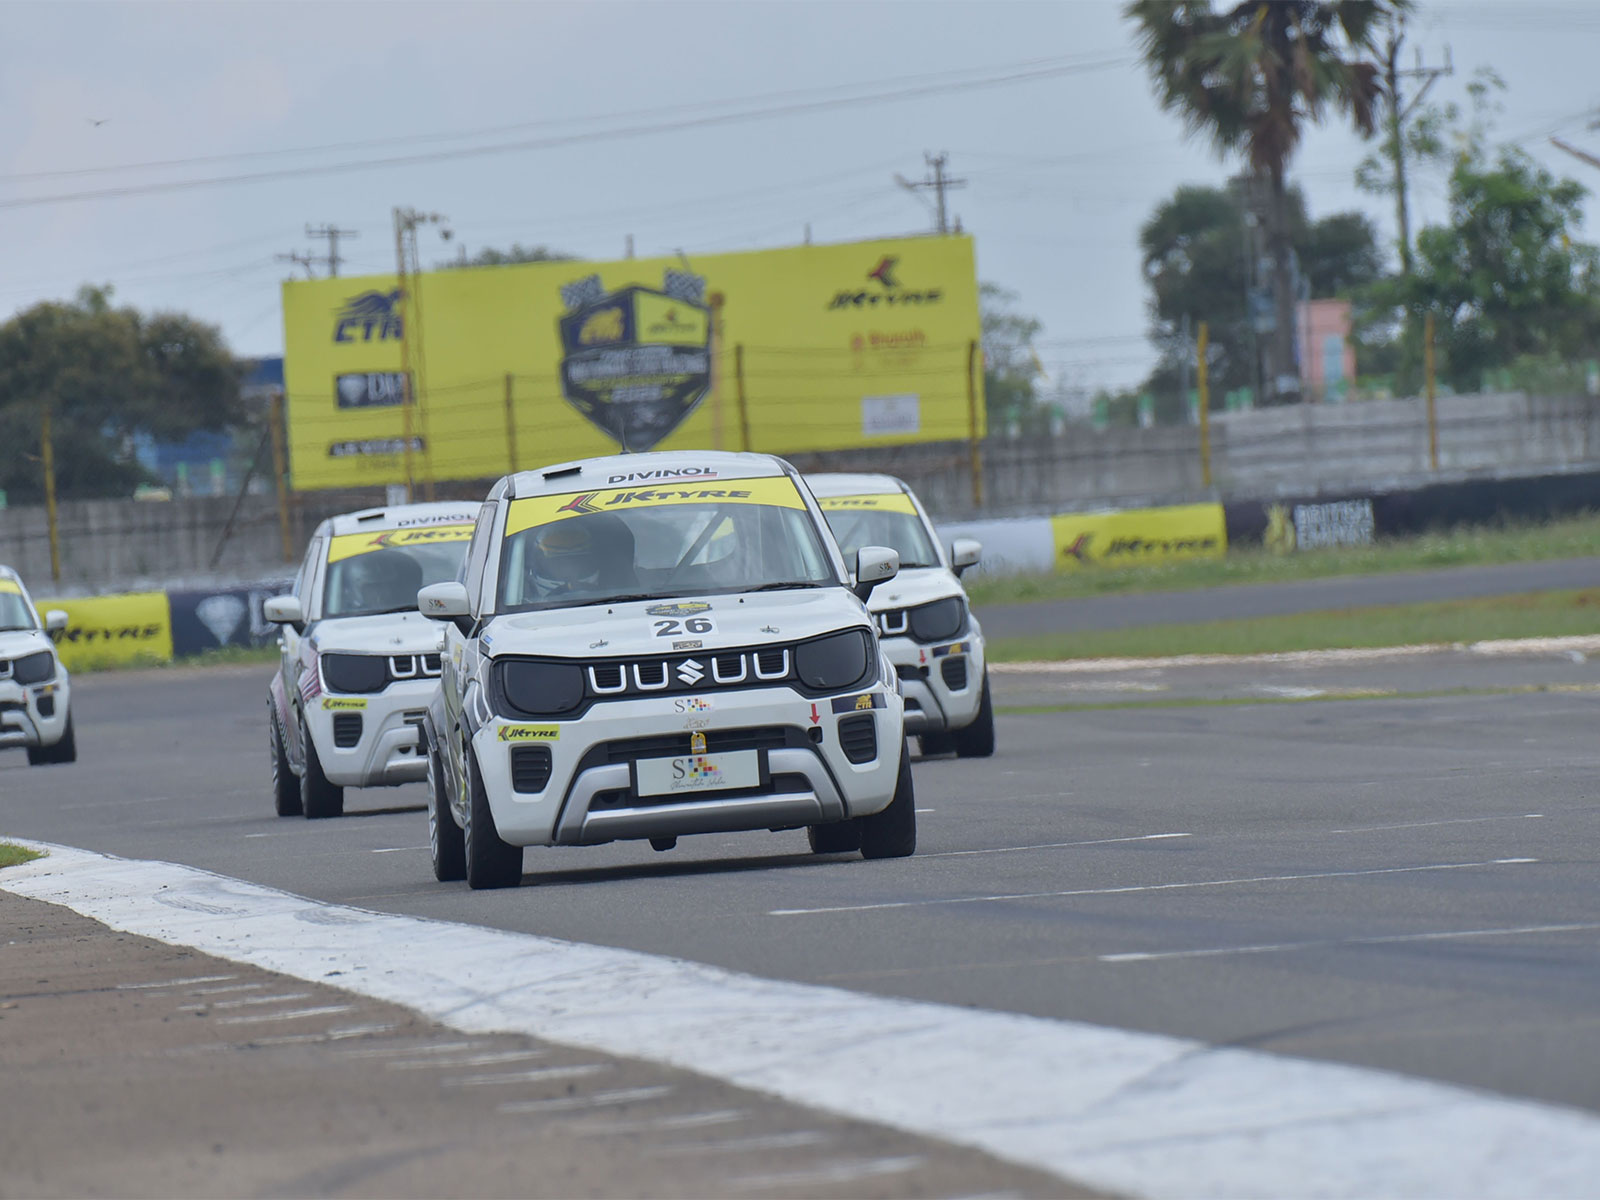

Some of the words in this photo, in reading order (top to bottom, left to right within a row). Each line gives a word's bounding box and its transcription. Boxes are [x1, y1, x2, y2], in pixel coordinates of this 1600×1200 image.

[608, 467, 714, 484] DIVINOL
[398, 514, 475, 526] DIVINOL
[653, 618, 713, 637] 26
[674, 699, 685, 713] S
[672, 759, 685, 779] S
